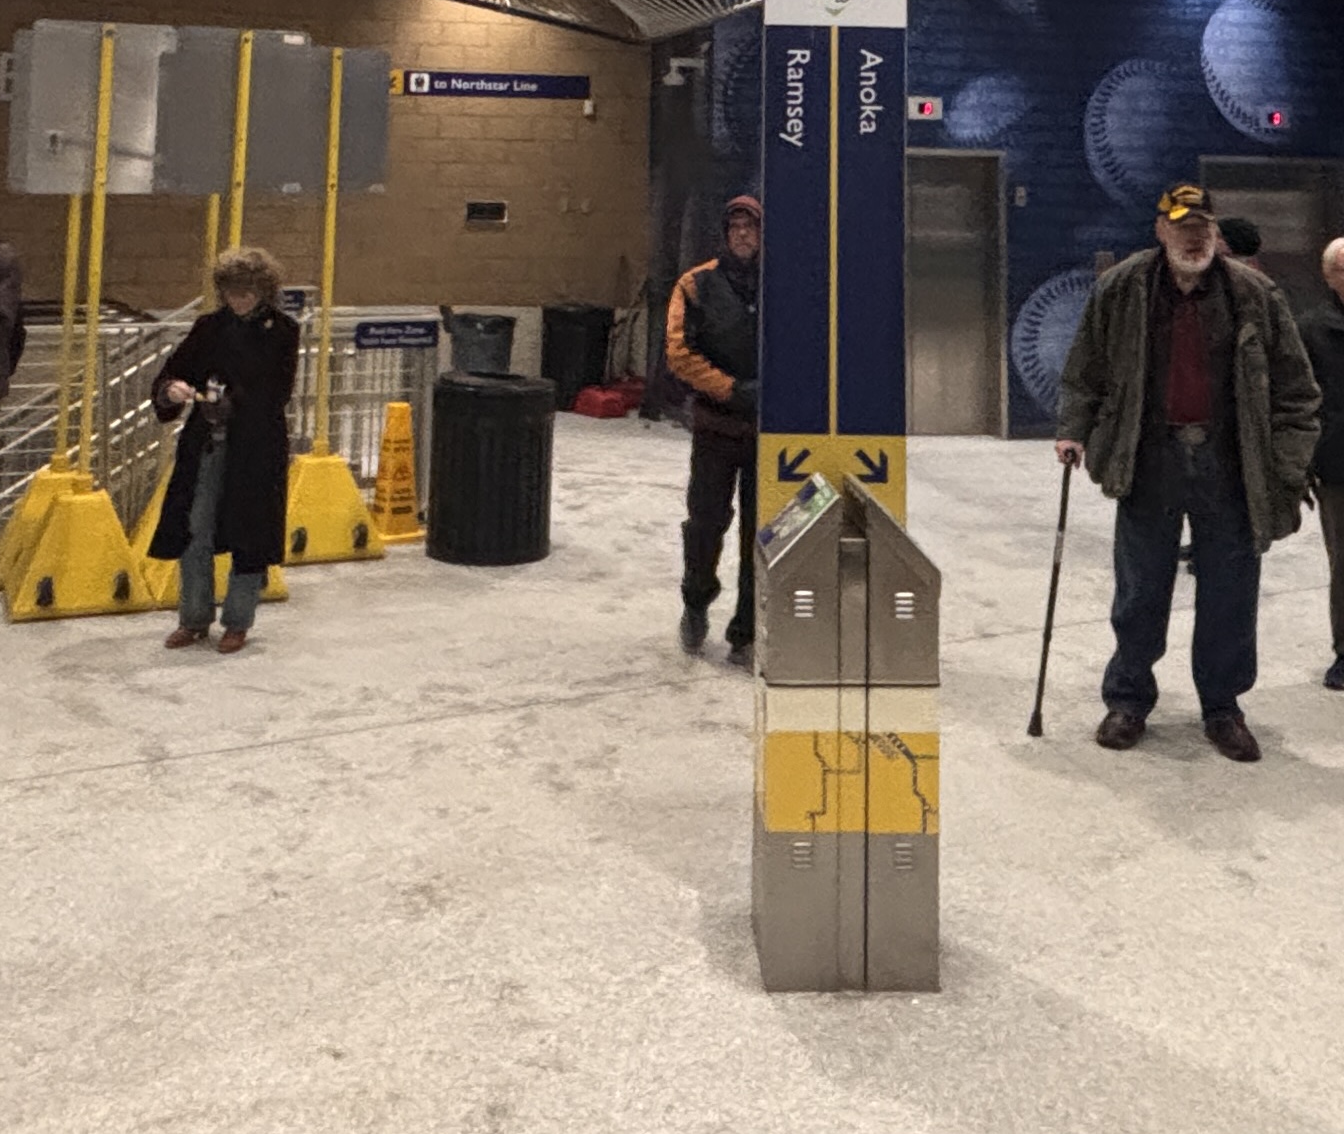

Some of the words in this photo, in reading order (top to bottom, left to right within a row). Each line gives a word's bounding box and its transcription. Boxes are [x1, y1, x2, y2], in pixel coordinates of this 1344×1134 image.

[433, 79, 448, 89] to
[451, 78, 509, 91] Northstar
[513, 79, 538, 92] Line
[778, 49, 811, 147] Ramsey
[859, 48, 884, 135] Anoka
